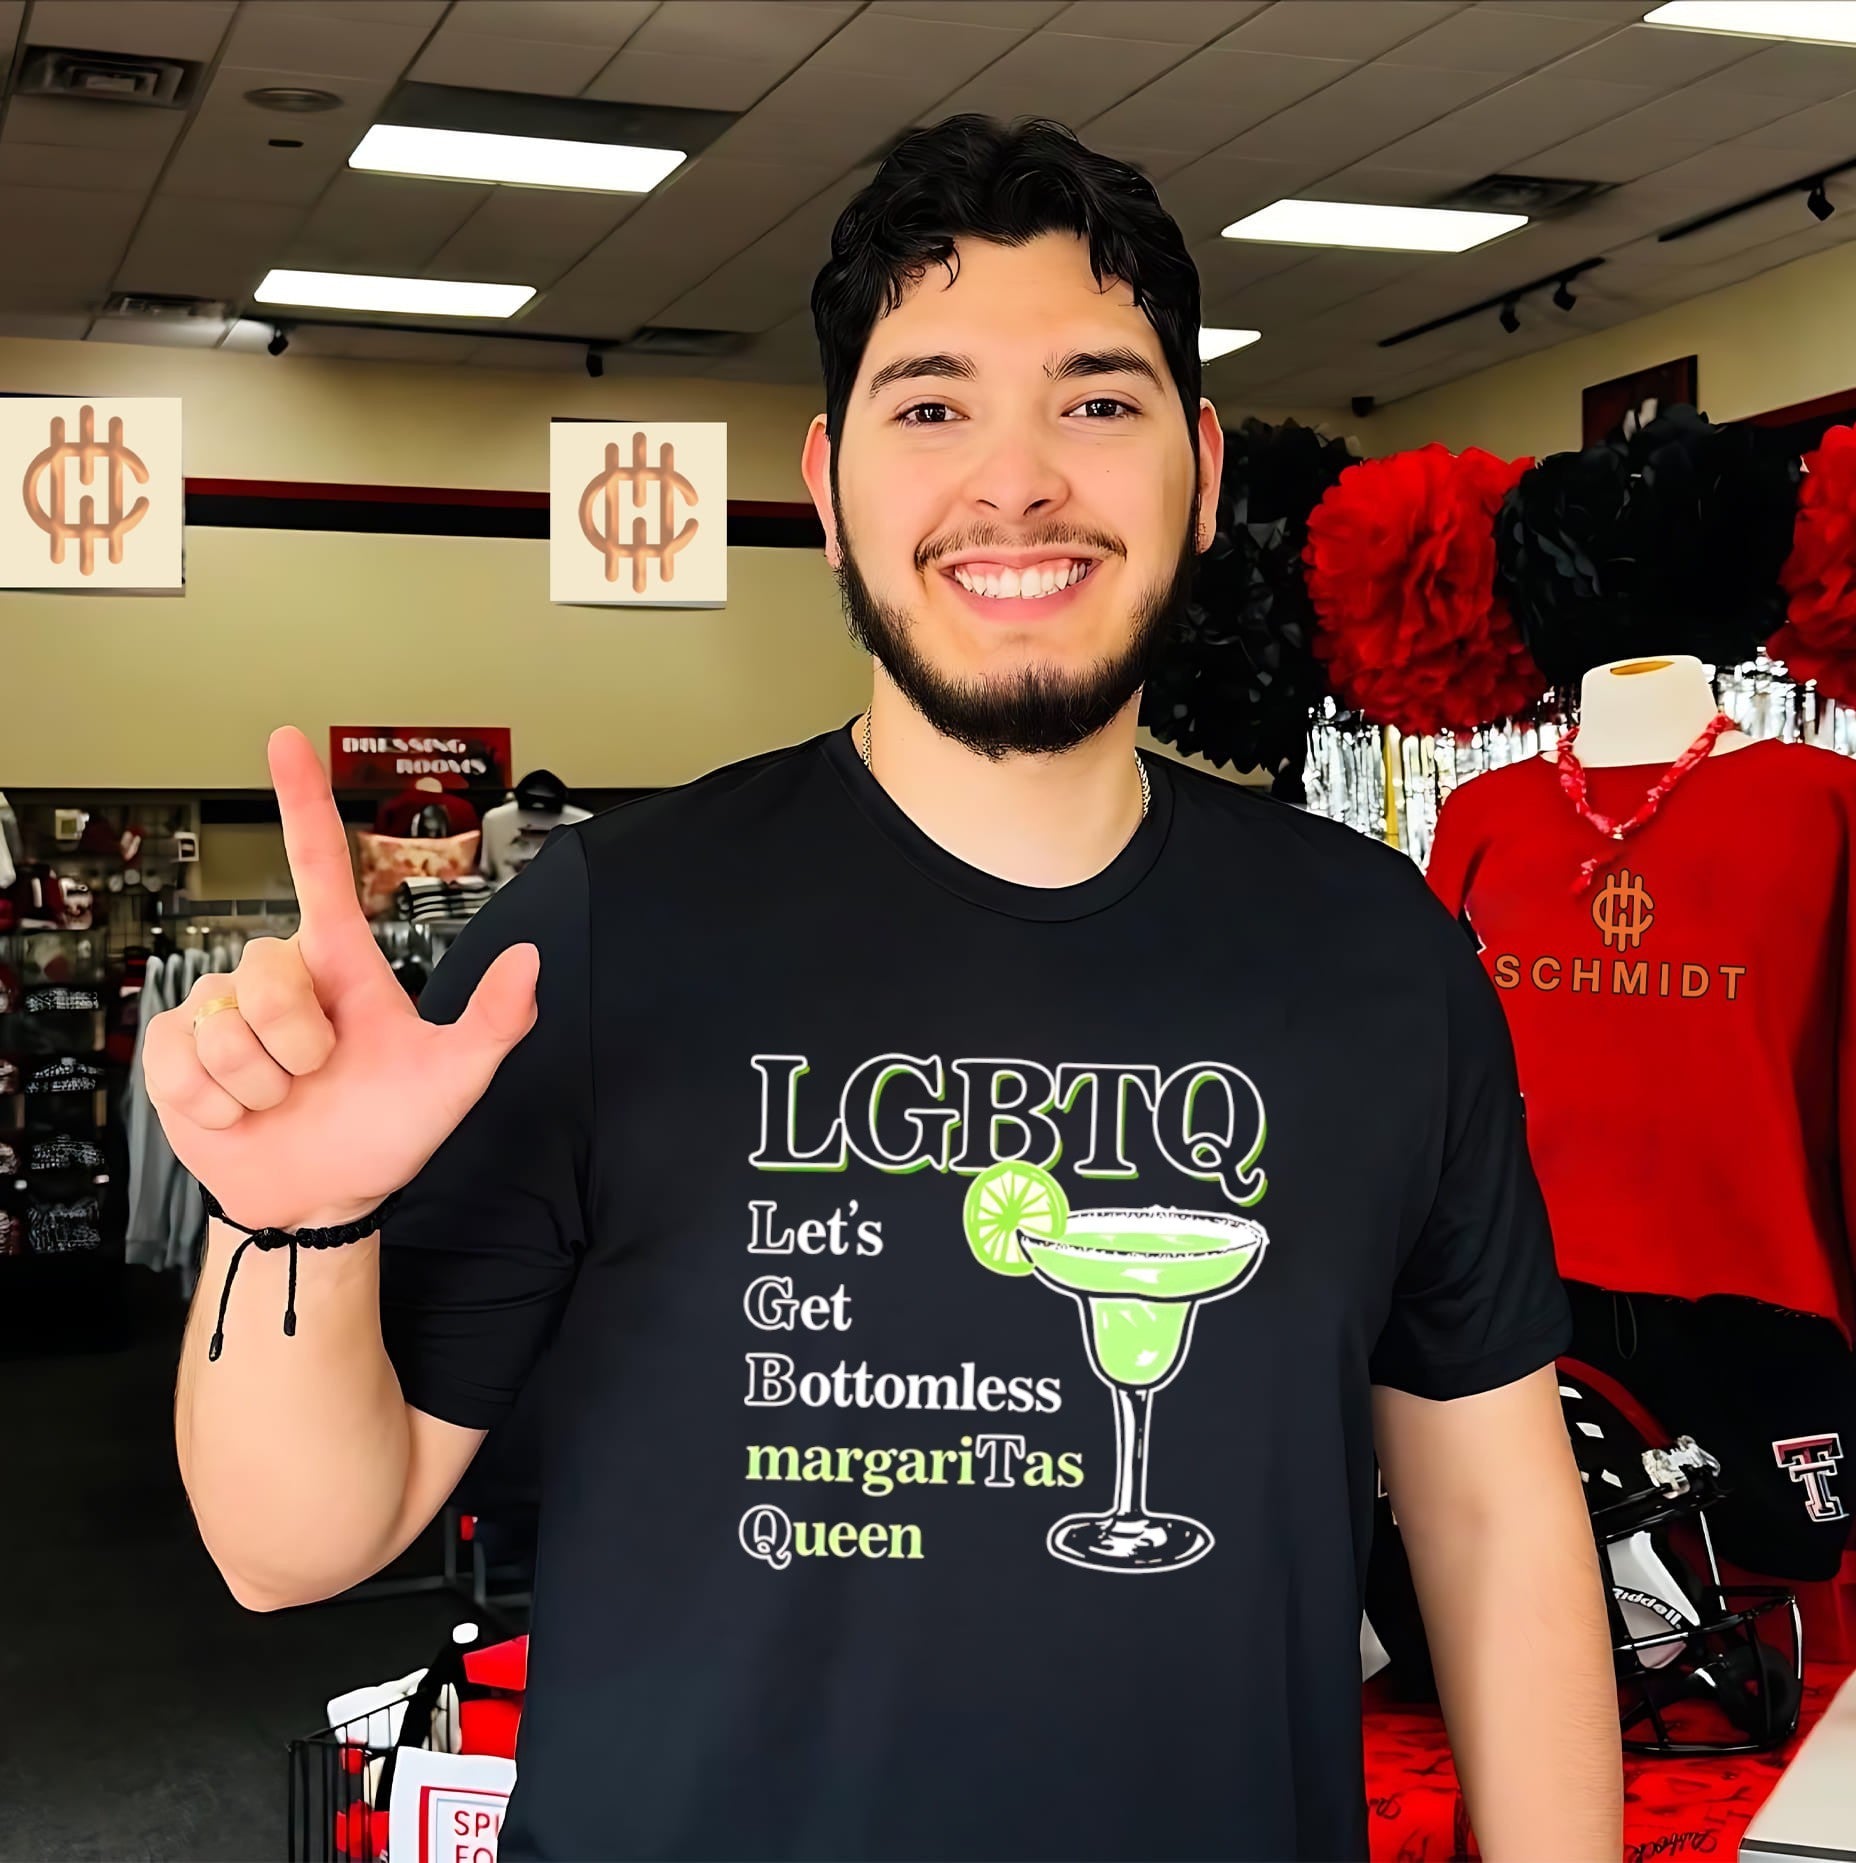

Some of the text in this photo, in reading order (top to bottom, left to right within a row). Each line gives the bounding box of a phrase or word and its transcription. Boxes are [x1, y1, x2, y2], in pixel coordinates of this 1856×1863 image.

[1494, 953, 1747, 1000] SCHMIDT
[748, 1053, 1268, 1206] LGBTQ
[747, 1200, 884, 1257] Let's
[743, 1275, 852, 1331] Get
[744, 1352, 1062, 1413] Bottomless
[745, 1434, 1085, 1497] margariTas
[738, 1504, 925, 1570] Queen
